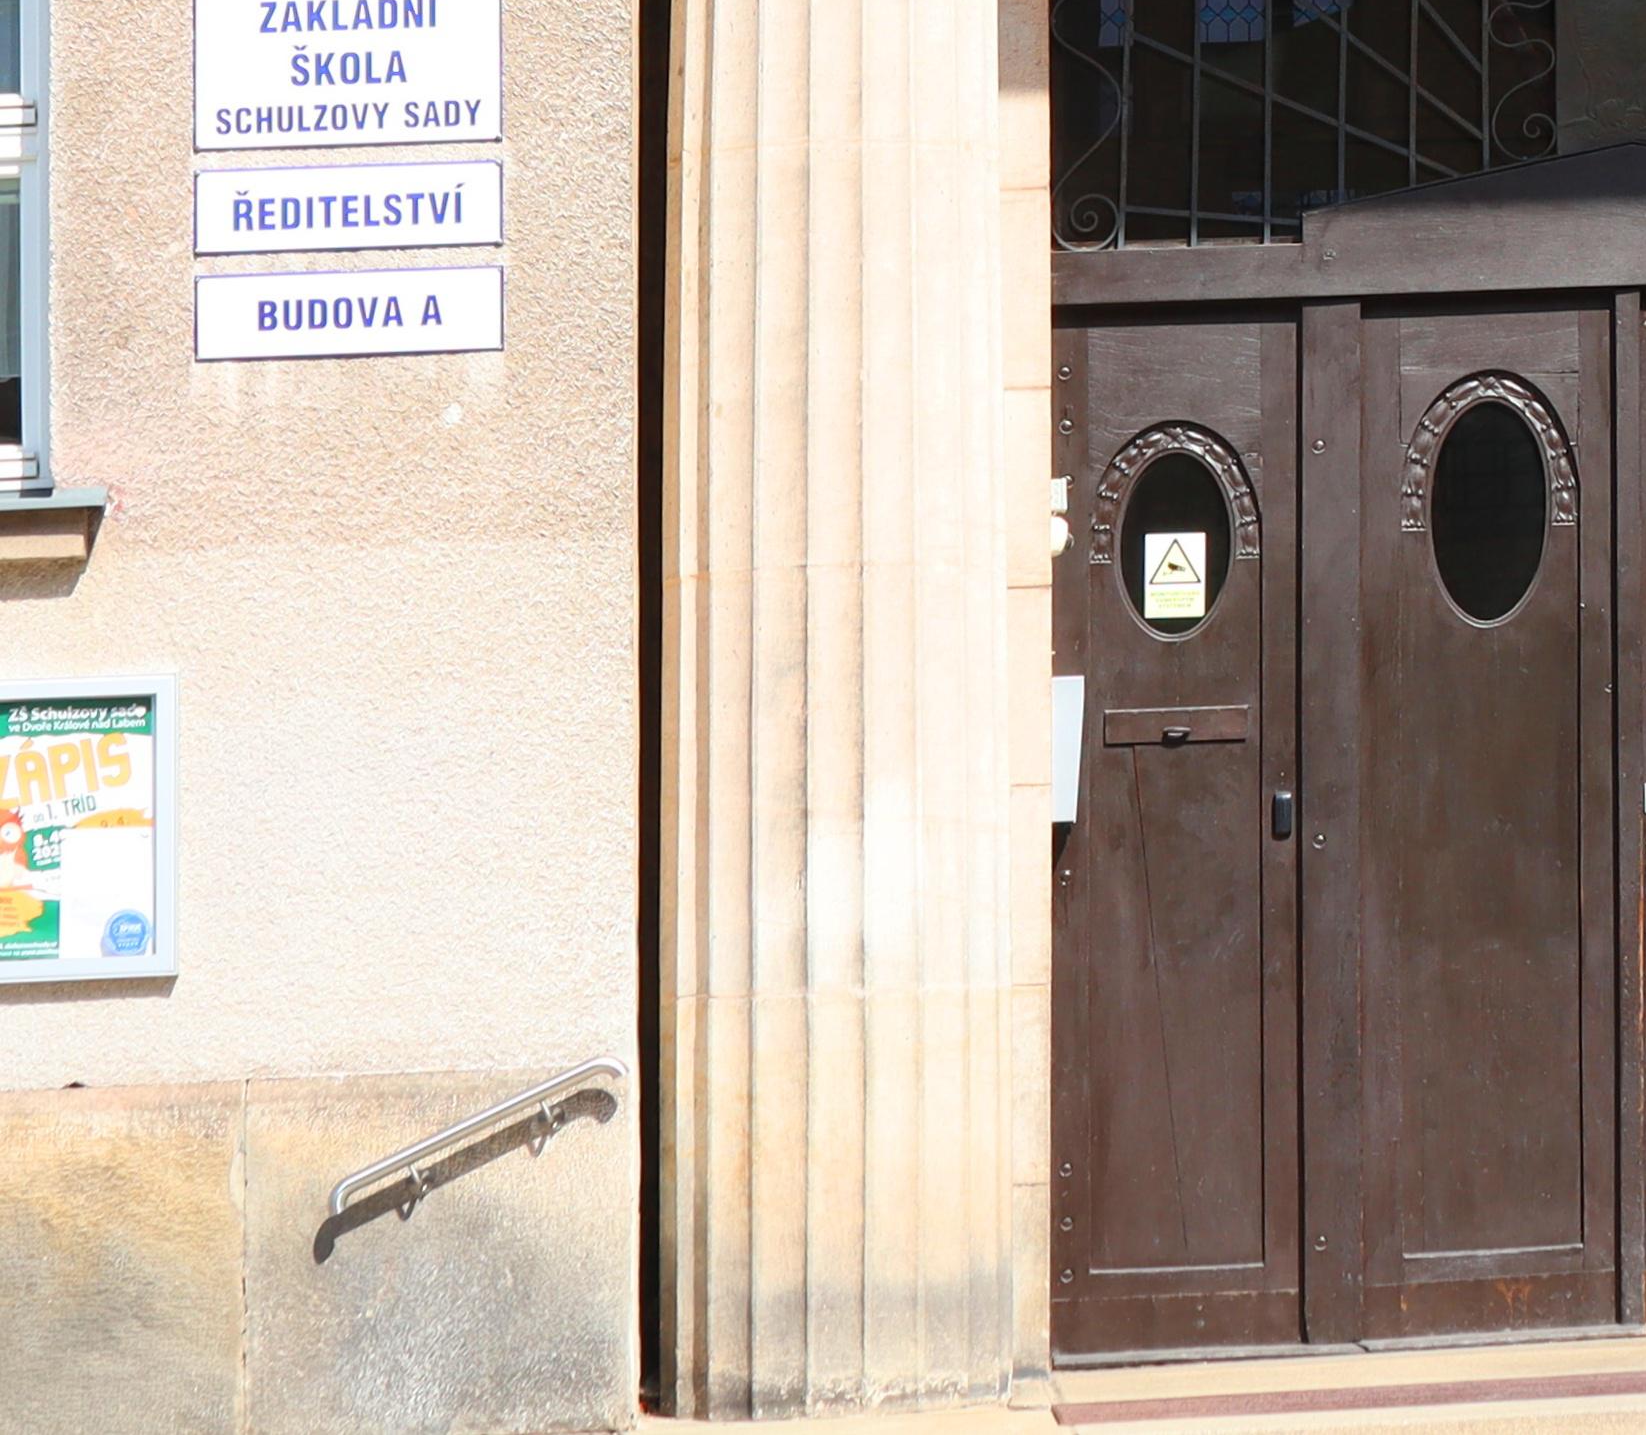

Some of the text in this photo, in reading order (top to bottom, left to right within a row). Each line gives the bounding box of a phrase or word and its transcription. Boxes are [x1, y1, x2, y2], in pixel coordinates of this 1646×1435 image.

[290, 45, 408, 87] ŠKOLA
[215, 98, 483, 136] SCHULZOVY SADY
[232, 182, 463, 233] ŘEDITELSTVÍ
[256, 294, 443, 332] BUDOVA A
[8, 705, 28, 723] ZŠ
[111, 703, 146, 719] sad
[112, 717, 146, 729] Labem
